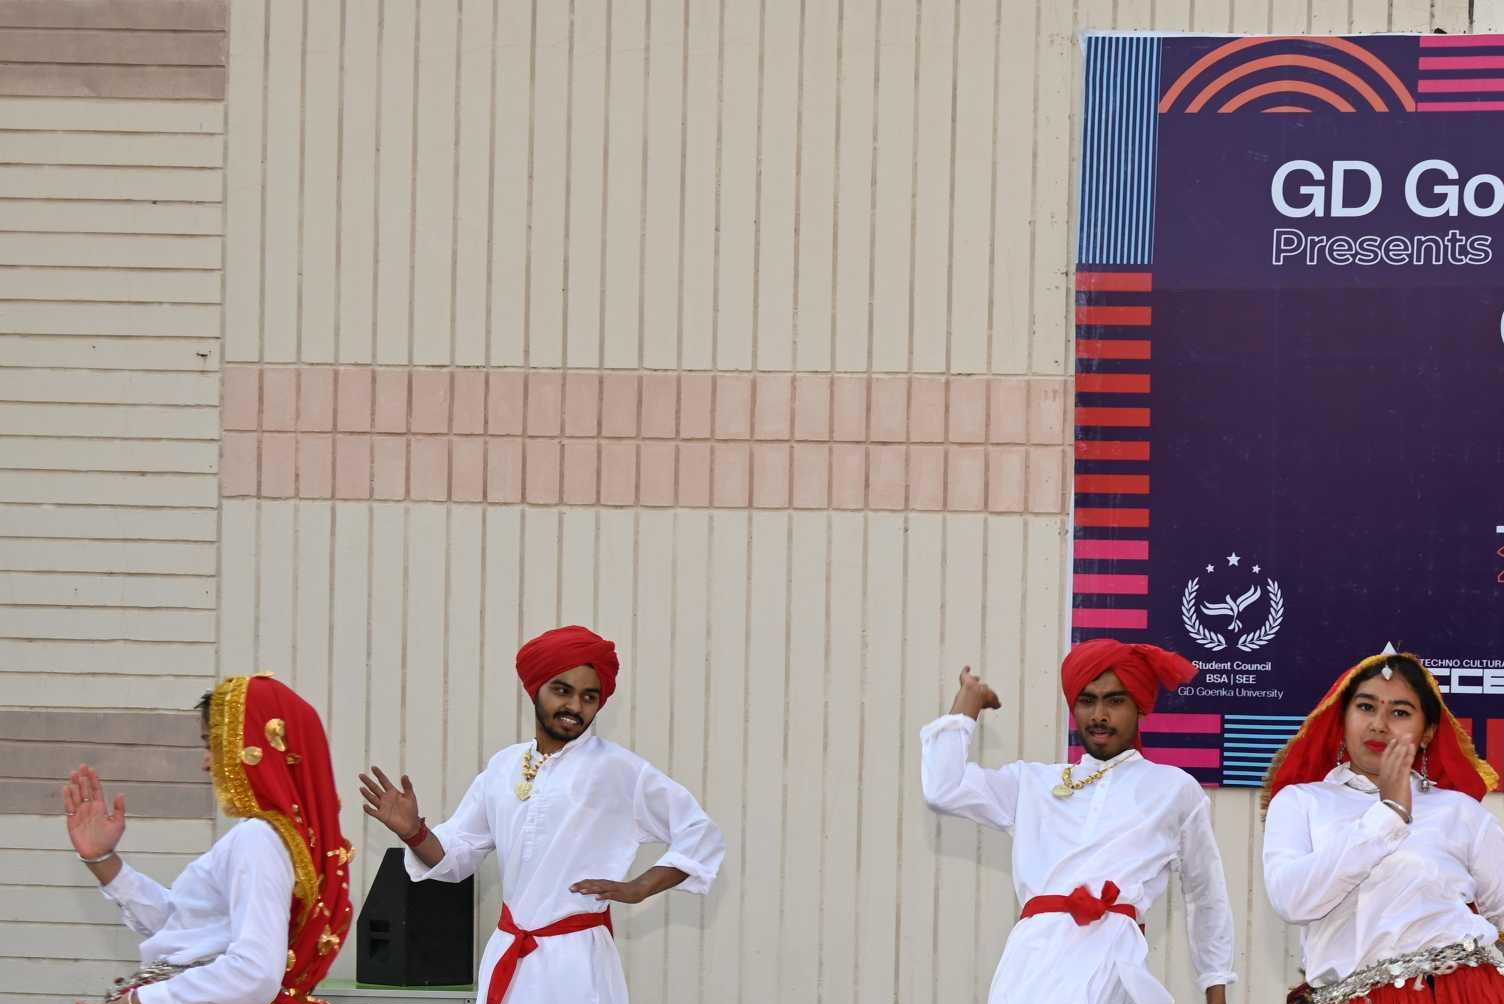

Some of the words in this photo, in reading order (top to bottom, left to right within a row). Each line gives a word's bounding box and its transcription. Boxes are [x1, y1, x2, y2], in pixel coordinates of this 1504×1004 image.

[1271, 159, 1382, 218] GD
[1271, 229, 1493, 266] Presents
[1191, 660, 1231, 670] Student
[1233, 661, 1272, 671] Council
[1419, 658, 1461, 668] TECHNO
[1206, 673, 1229, 683] BSA
[1235, 675, 1257, 684] SEE
[1177, 686, 1195, 696] GD
[1196, 687, 1234, 697] Goenka
[1235, 688, 1284, 700] University
